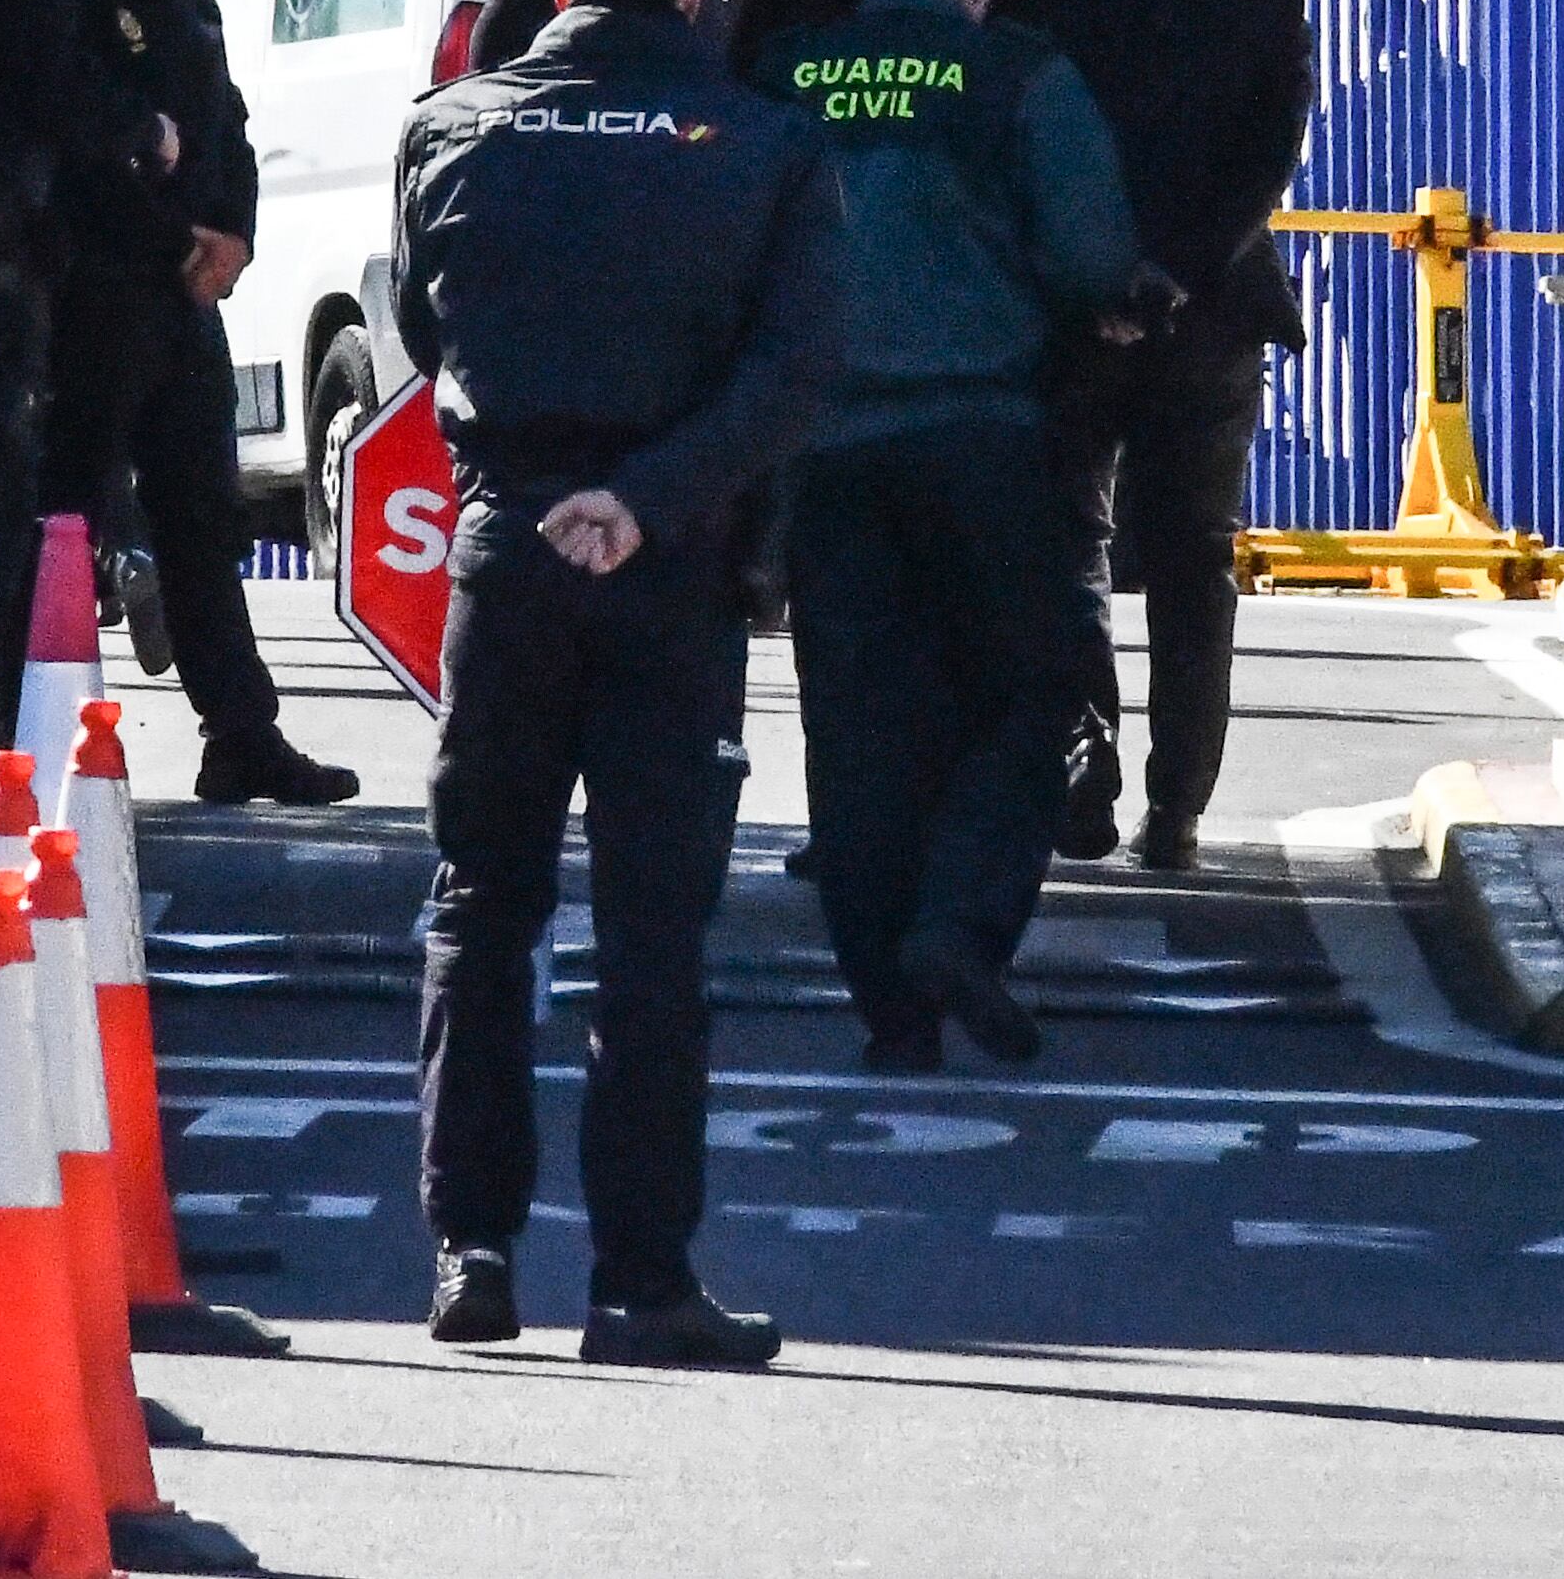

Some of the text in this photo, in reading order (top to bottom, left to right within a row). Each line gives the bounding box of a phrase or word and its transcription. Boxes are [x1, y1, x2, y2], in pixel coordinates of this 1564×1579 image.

[793, 57, 963, 93] GUARDIA
[824, 91, 915, 119] CIVIL
[475, 107, 678, 136] POLICIA
